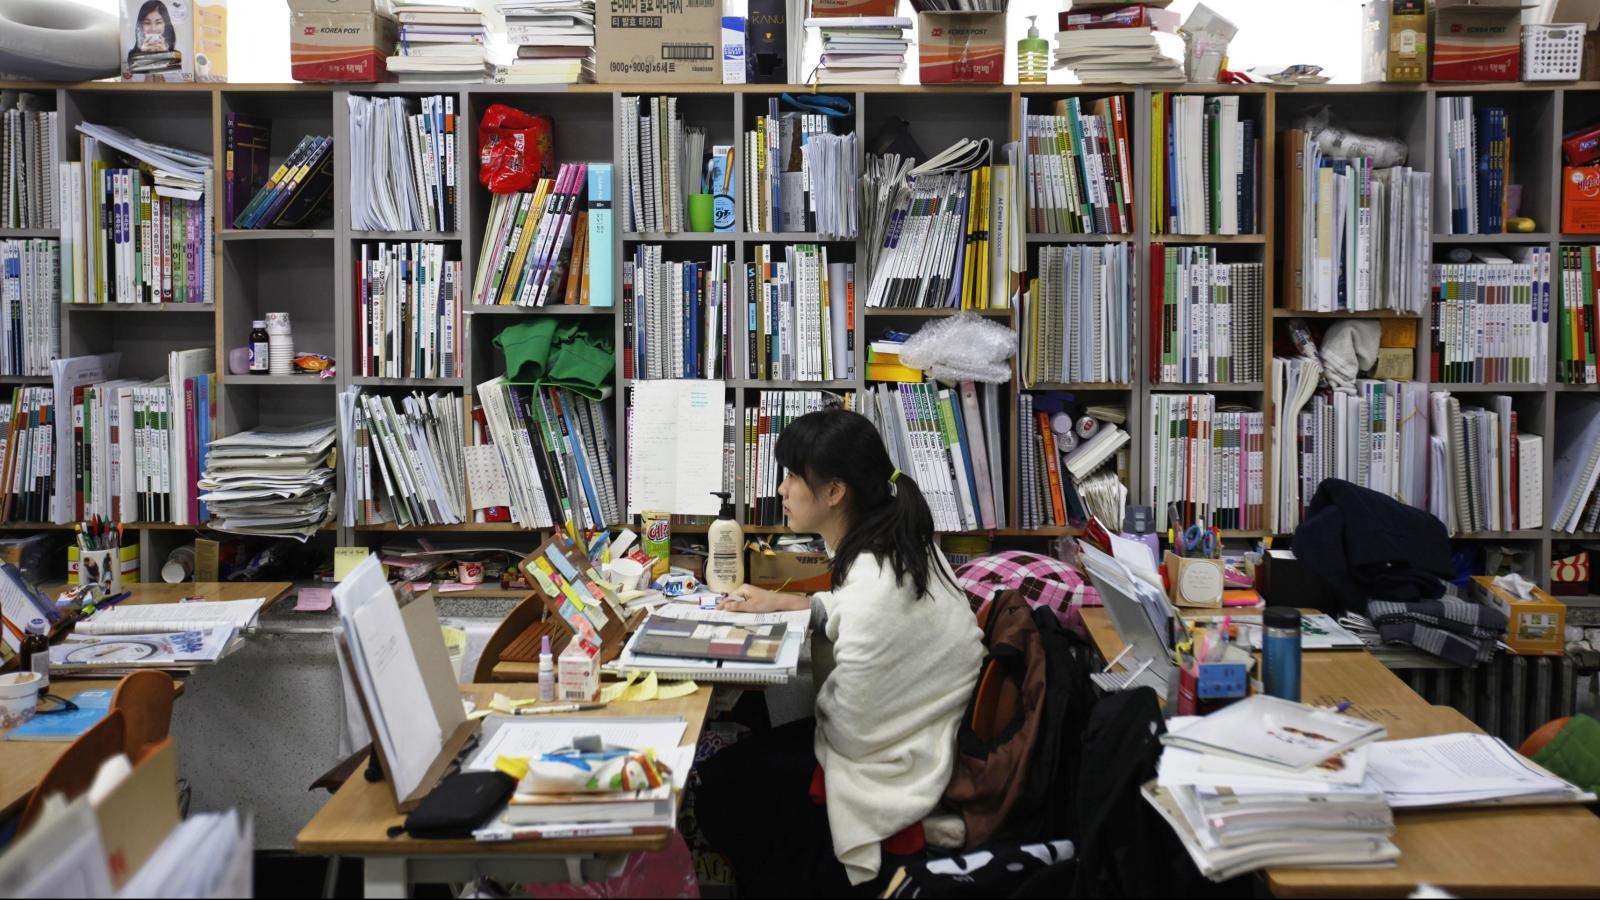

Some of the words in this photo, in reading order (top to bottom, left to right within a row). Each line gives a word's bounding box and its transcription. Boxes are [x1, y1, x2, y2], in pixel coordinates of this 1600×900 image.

[752, 15, 784, 24] KANU
[320, 27, 342, 35] KOREA
[343, 27, 361, 35] POST
[801, 556, 819, 564] EMS
